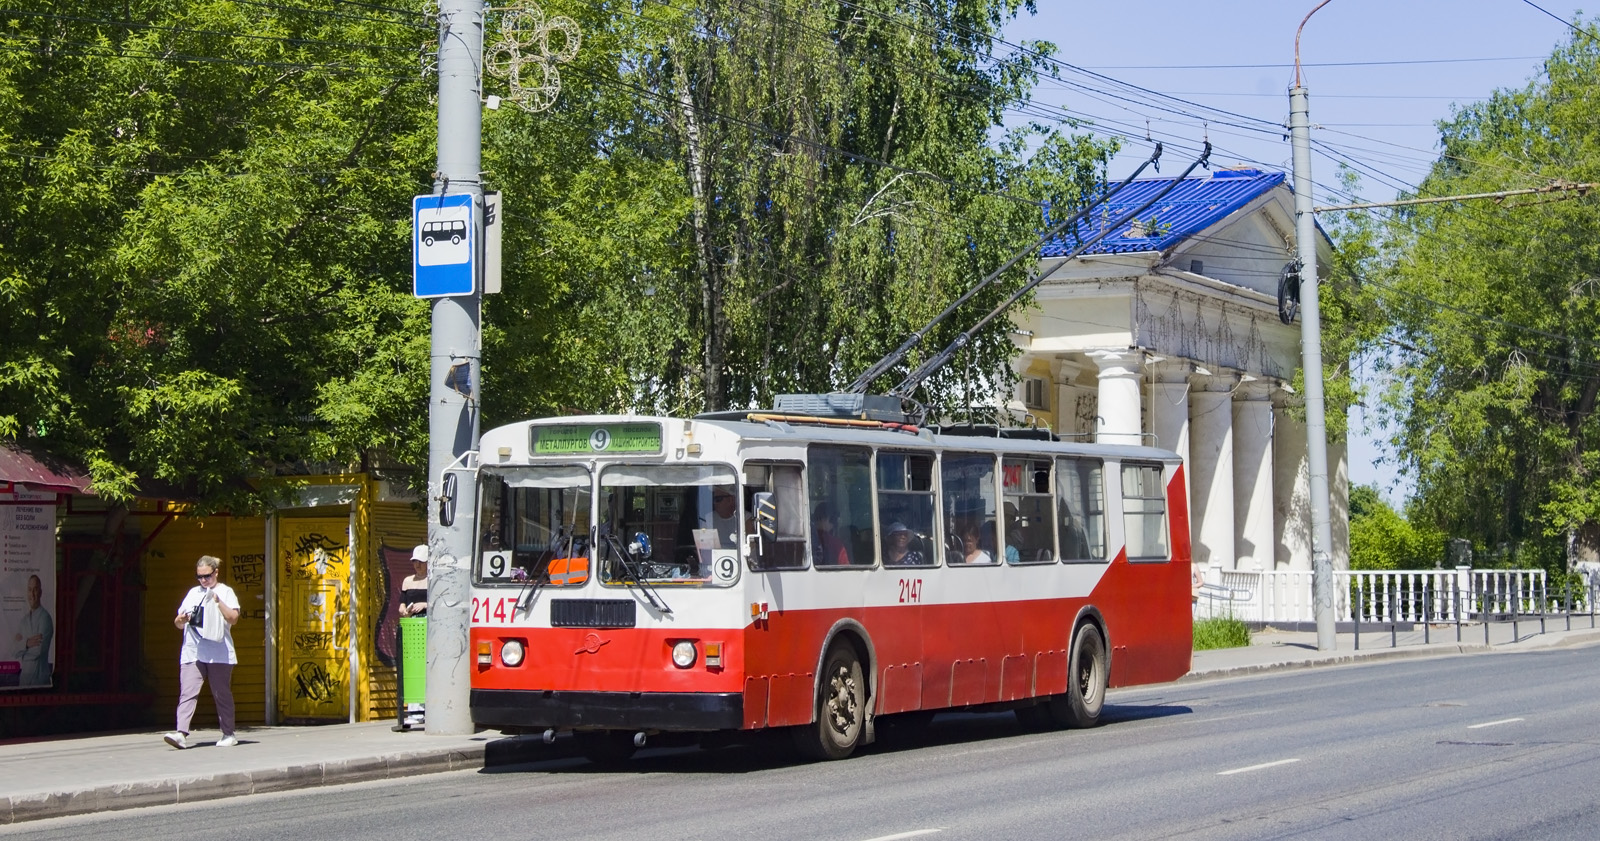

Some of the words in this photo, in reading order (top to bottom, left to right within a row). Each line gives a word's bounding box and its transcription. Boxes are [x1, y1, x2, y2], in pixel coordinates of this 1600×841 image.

[540, 438, 588, 450] МЕТАЛЛУРГОВ
[594, 430, 607, 449] 9
[489, 555, 506, 578] 9
[721, 558, 734, 578] 9
[899, 578, 922, 603] 2147
[471, 597, 520, 623] 2147
